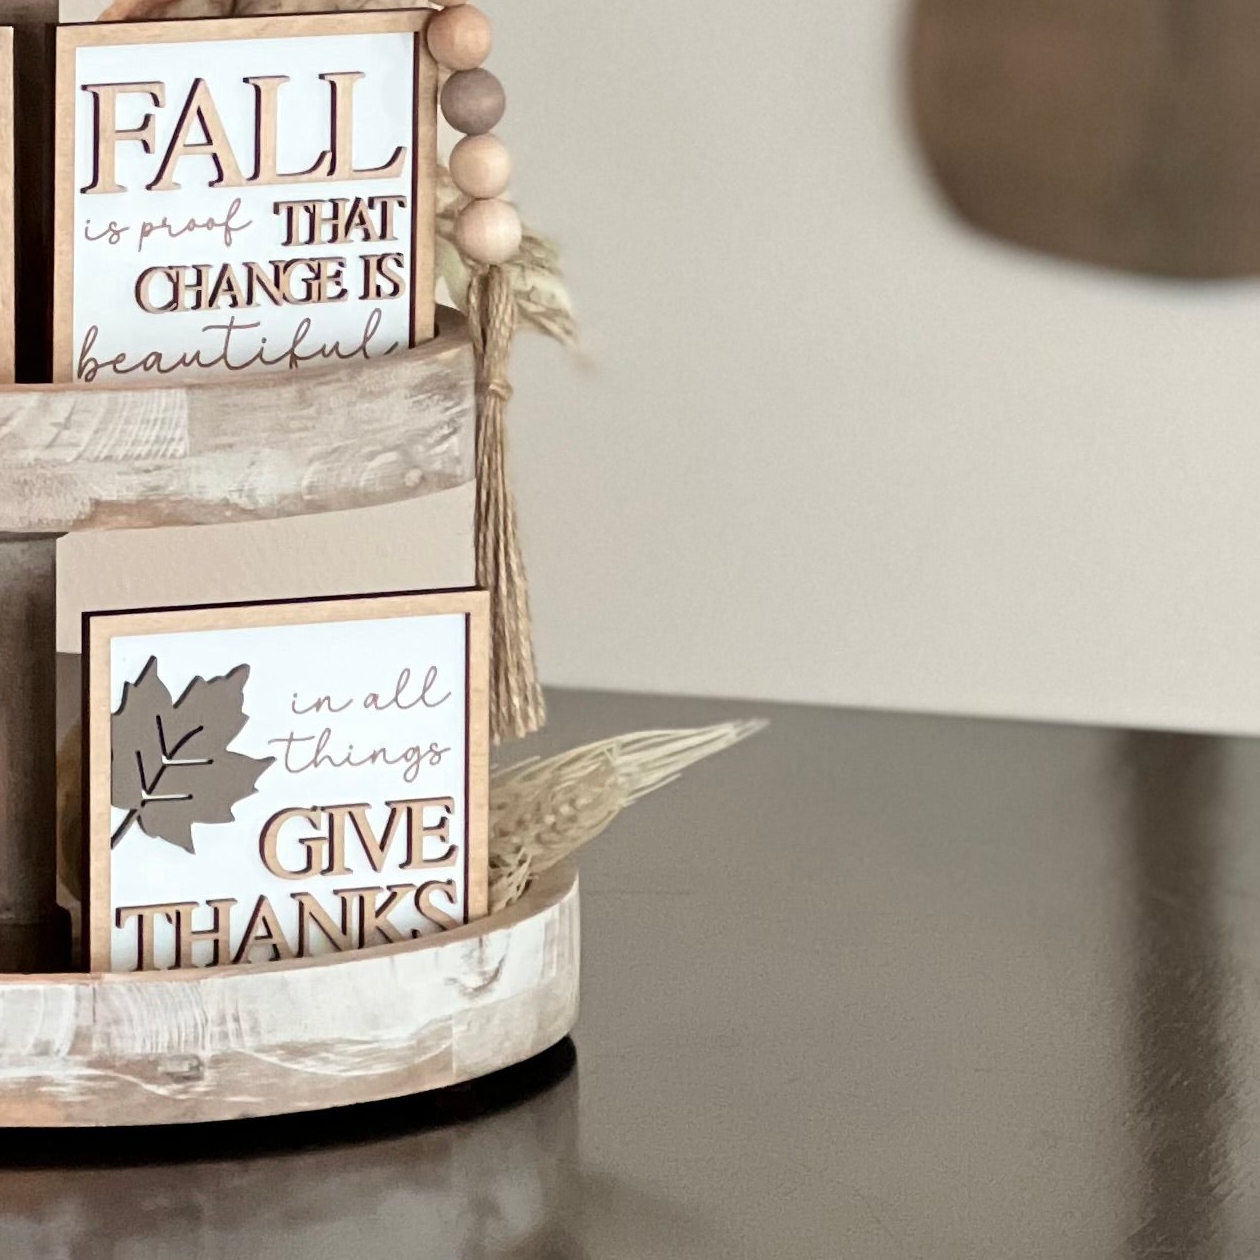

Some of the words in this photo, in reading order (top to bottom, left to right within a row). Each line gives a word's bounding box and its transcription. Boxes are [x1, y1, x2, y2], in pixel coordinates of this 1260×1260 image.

[80, 71, 407, 194] FALL
[84, 219, 130, 245] is
[138, 197, 253, 253] proof
[273, 195, 407, 247] THAT
[134, 256, 348, 314] CHANGE
[358, 252, 406, 301] IS
[77, 307, 399, 383] beautiful
[291, 692, 354, 715] in
[362, 666, 452, 711] all
[267, 728, 452, 783] things
[259, 796, 459, 881] GIVE
[115, 879, 460, 972] THANKS
